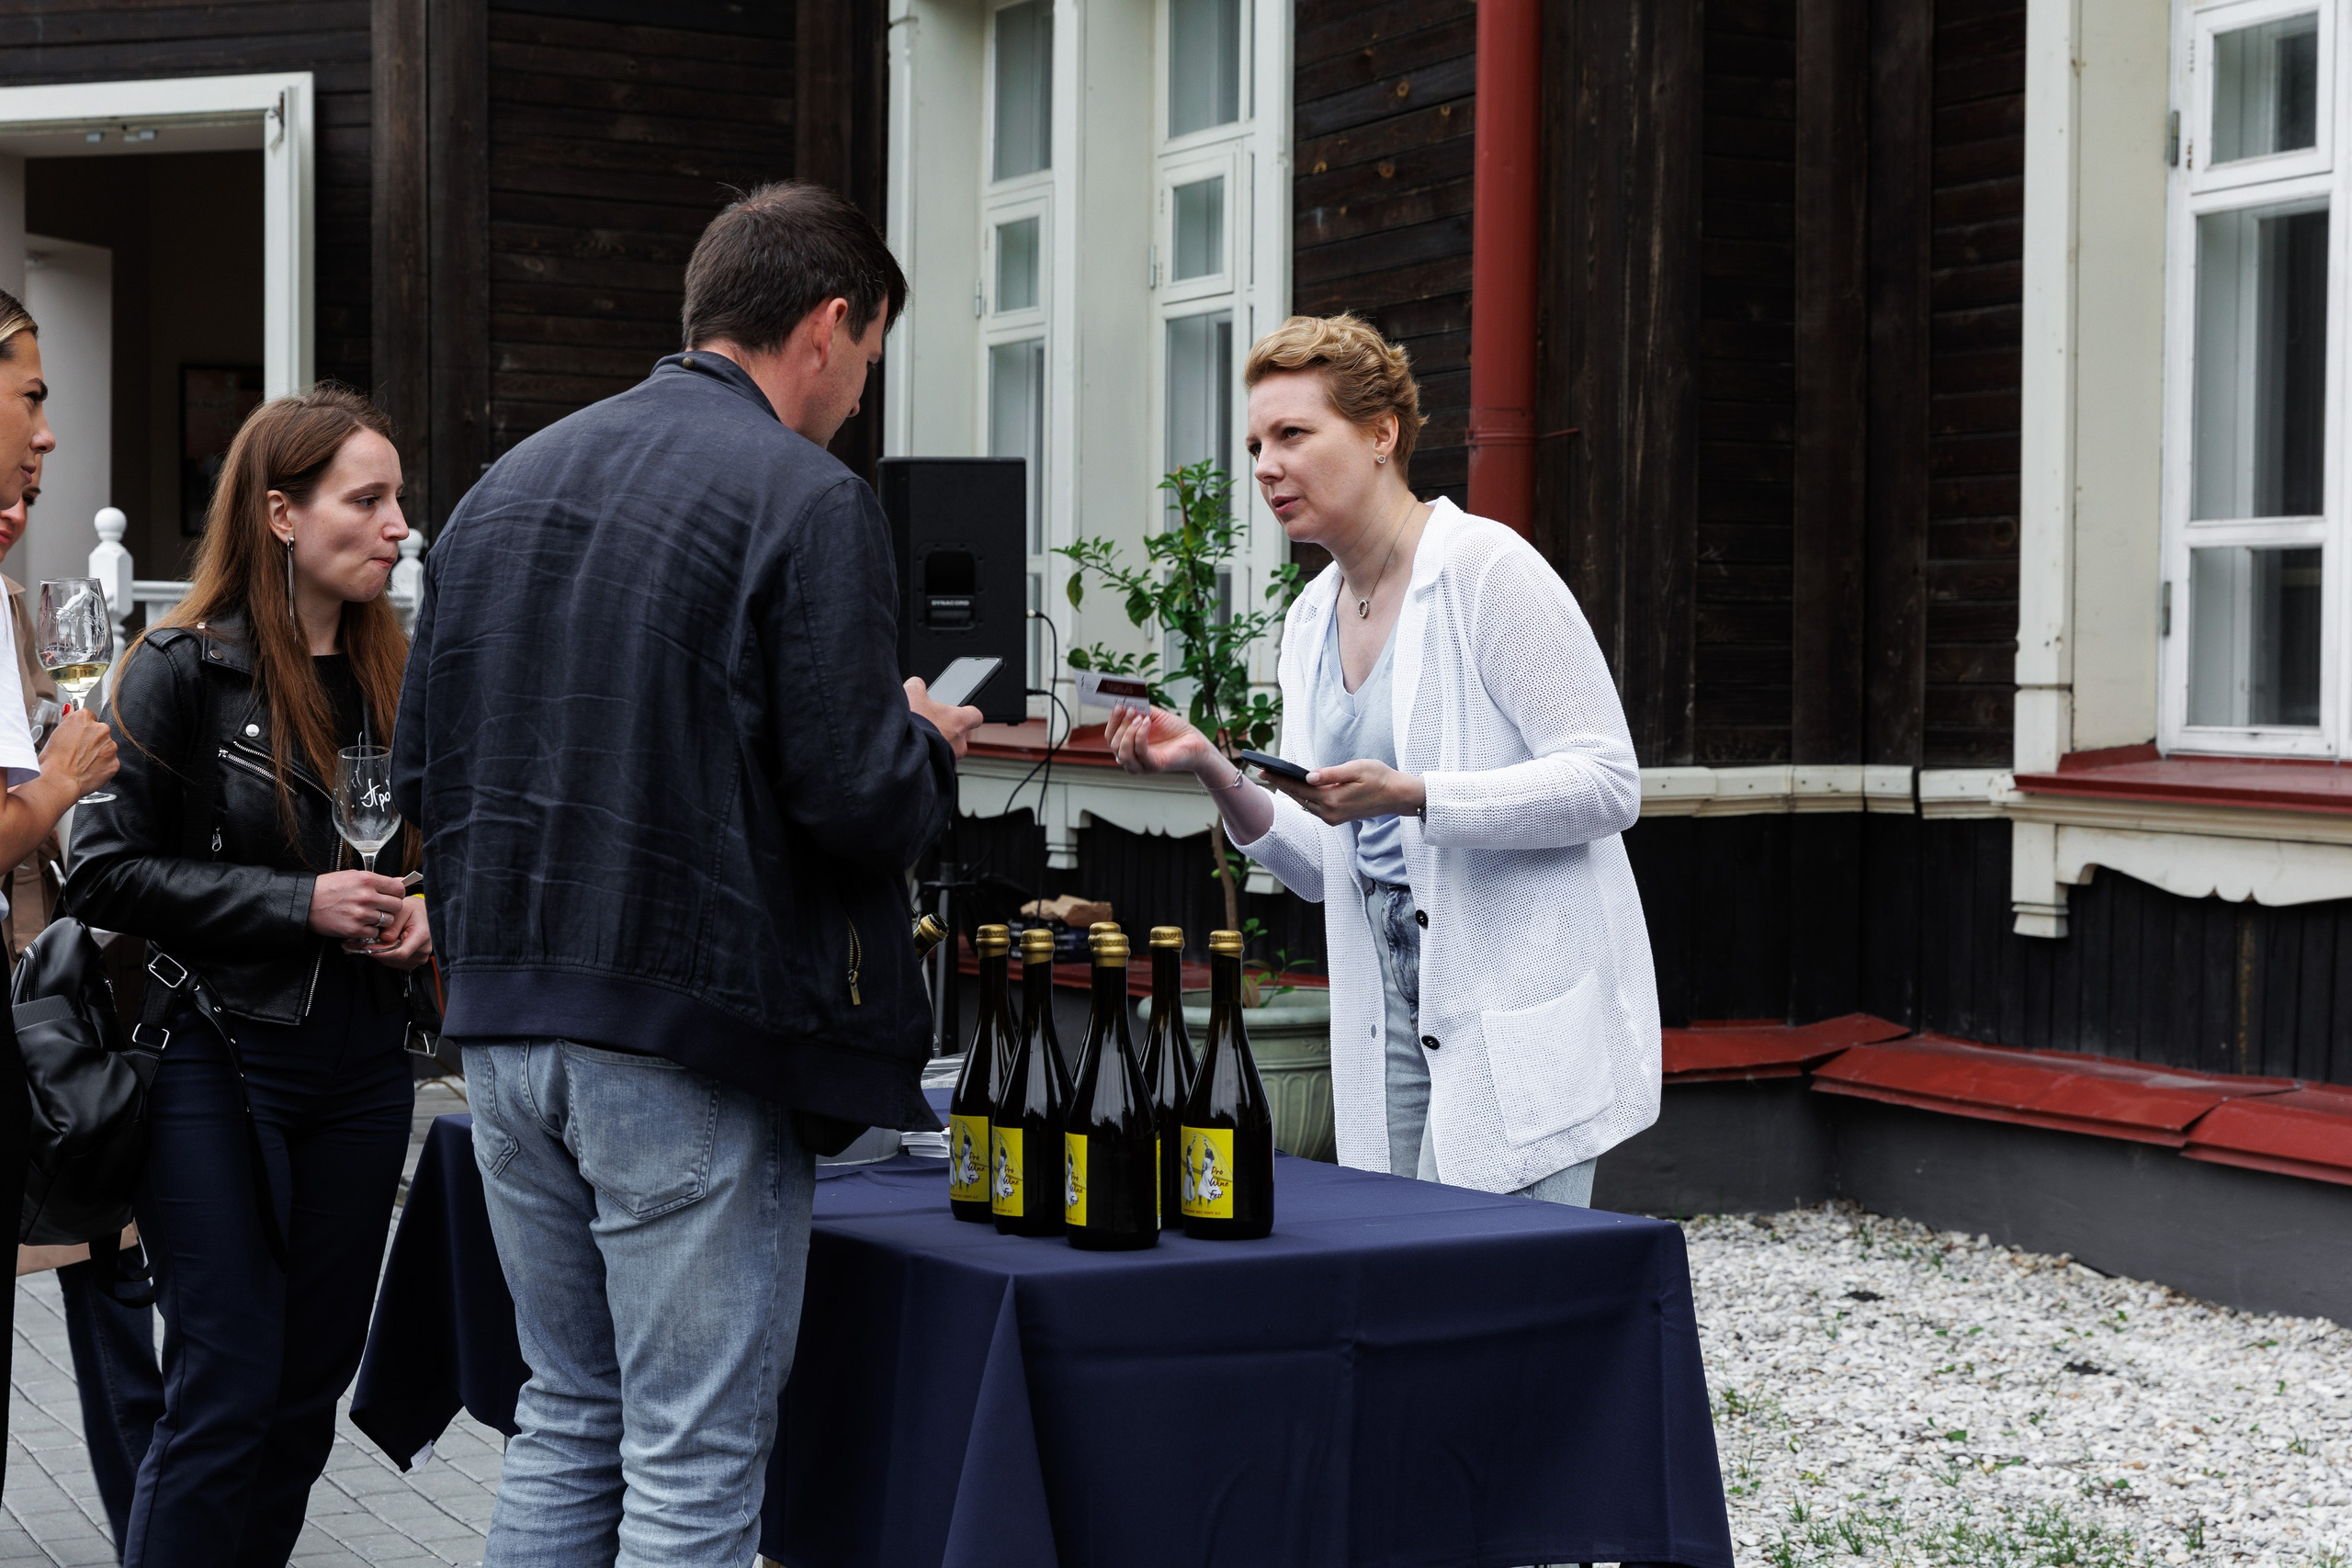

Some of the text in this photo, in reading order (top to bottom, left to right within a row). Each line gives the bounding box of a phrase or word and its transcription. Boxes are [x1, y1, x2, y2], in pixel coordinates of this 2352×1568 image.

[969, 1152, 979, 1161] Pro
[967, 1163, 985, 1172] Wine
[1004, 1165, 1014, 1173] Pro
[1211, 1167, 1224, 1175] Pro
[967, 1175, 980, 1184] Fest
[1003, 1177, 1019, 1186] Wine
[1209, 1178, 1229, 1187] Wine
[1003, 1188, 1014, 1197] Fest
[1209, 1190, 1224, 1199] Fest
